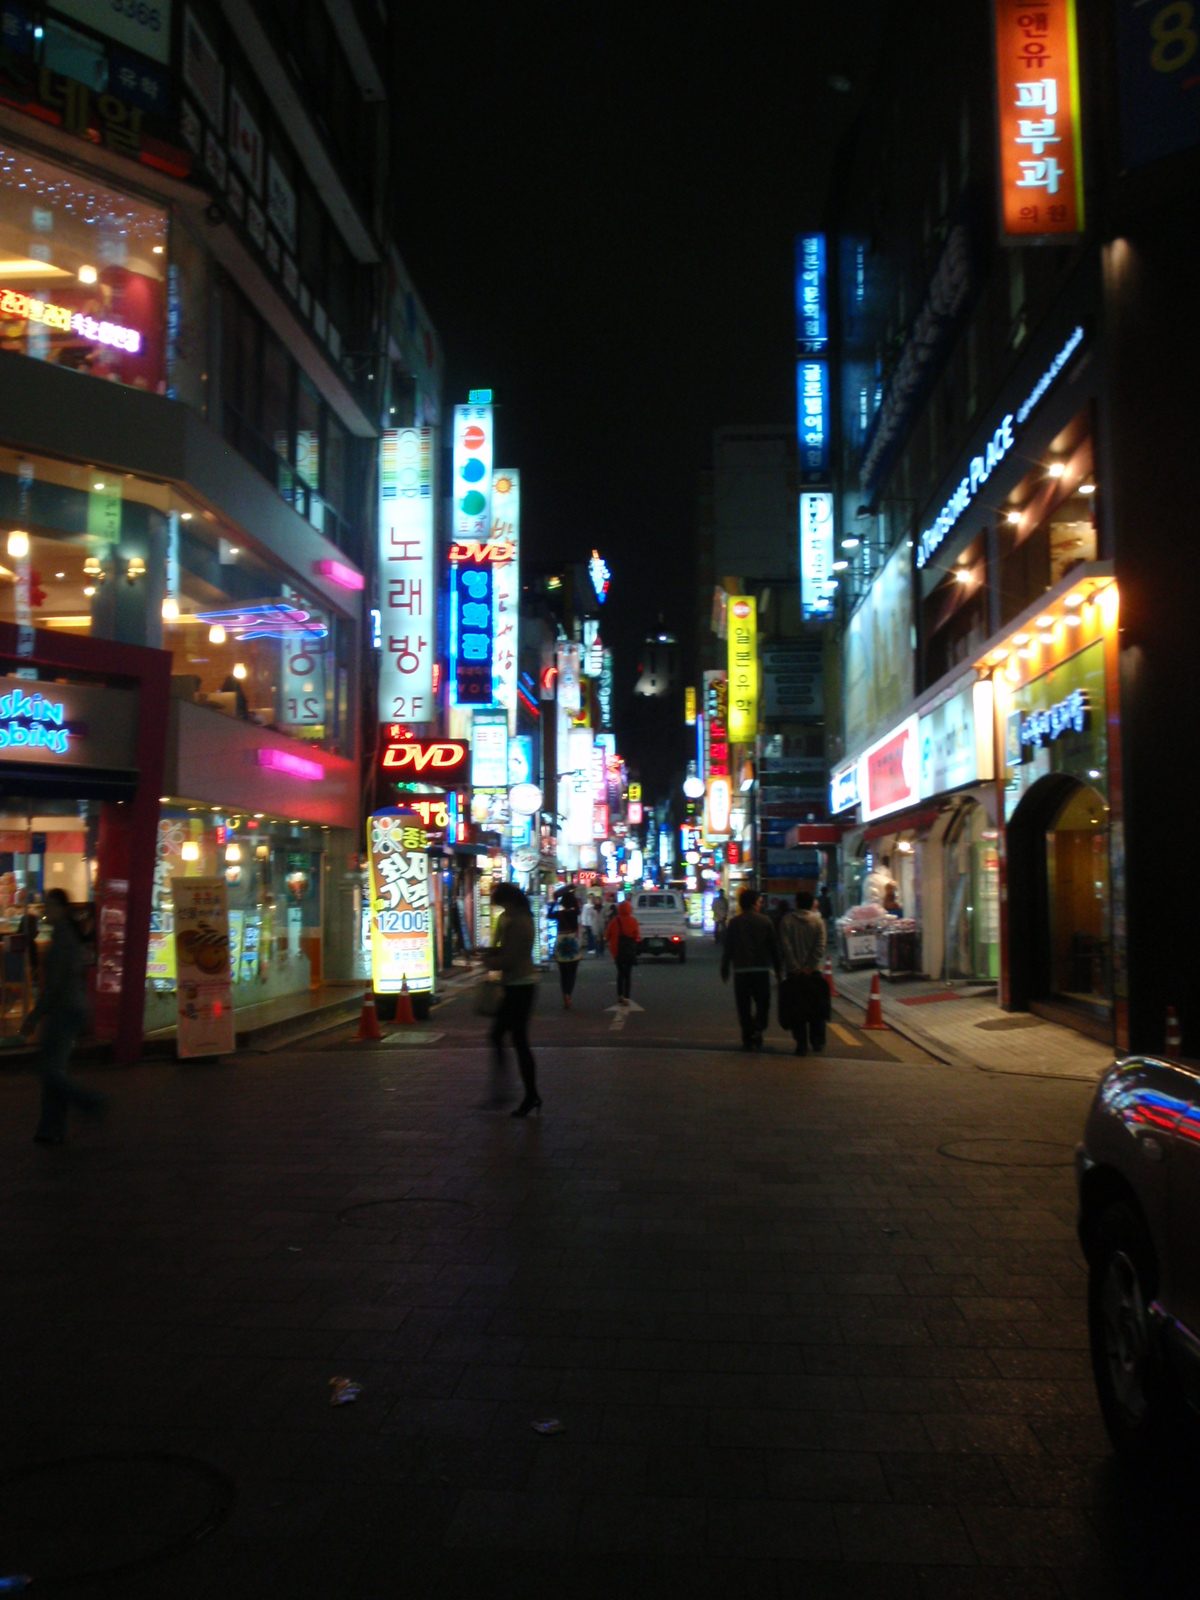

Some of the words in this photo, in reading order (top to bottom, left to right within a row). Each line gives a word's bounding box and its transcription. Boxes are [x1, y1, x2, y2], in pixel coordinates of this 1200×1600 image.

[1014, 0, 1051, 68] 앤유
[1014, 78, 1064, 195] 피부과
[1018, 204, 1068, 224] 의원
[449, 543, 514, 563] DVD
[387, 526, 427, 675] 노래방
[391, 696, 424, 718] 2F
[382, 743, 465, 771] DVD
[377, 852, 429, 883] 최저
[379, 877, 430, 909] 가격
[377, 911, 425, 933] 1200
